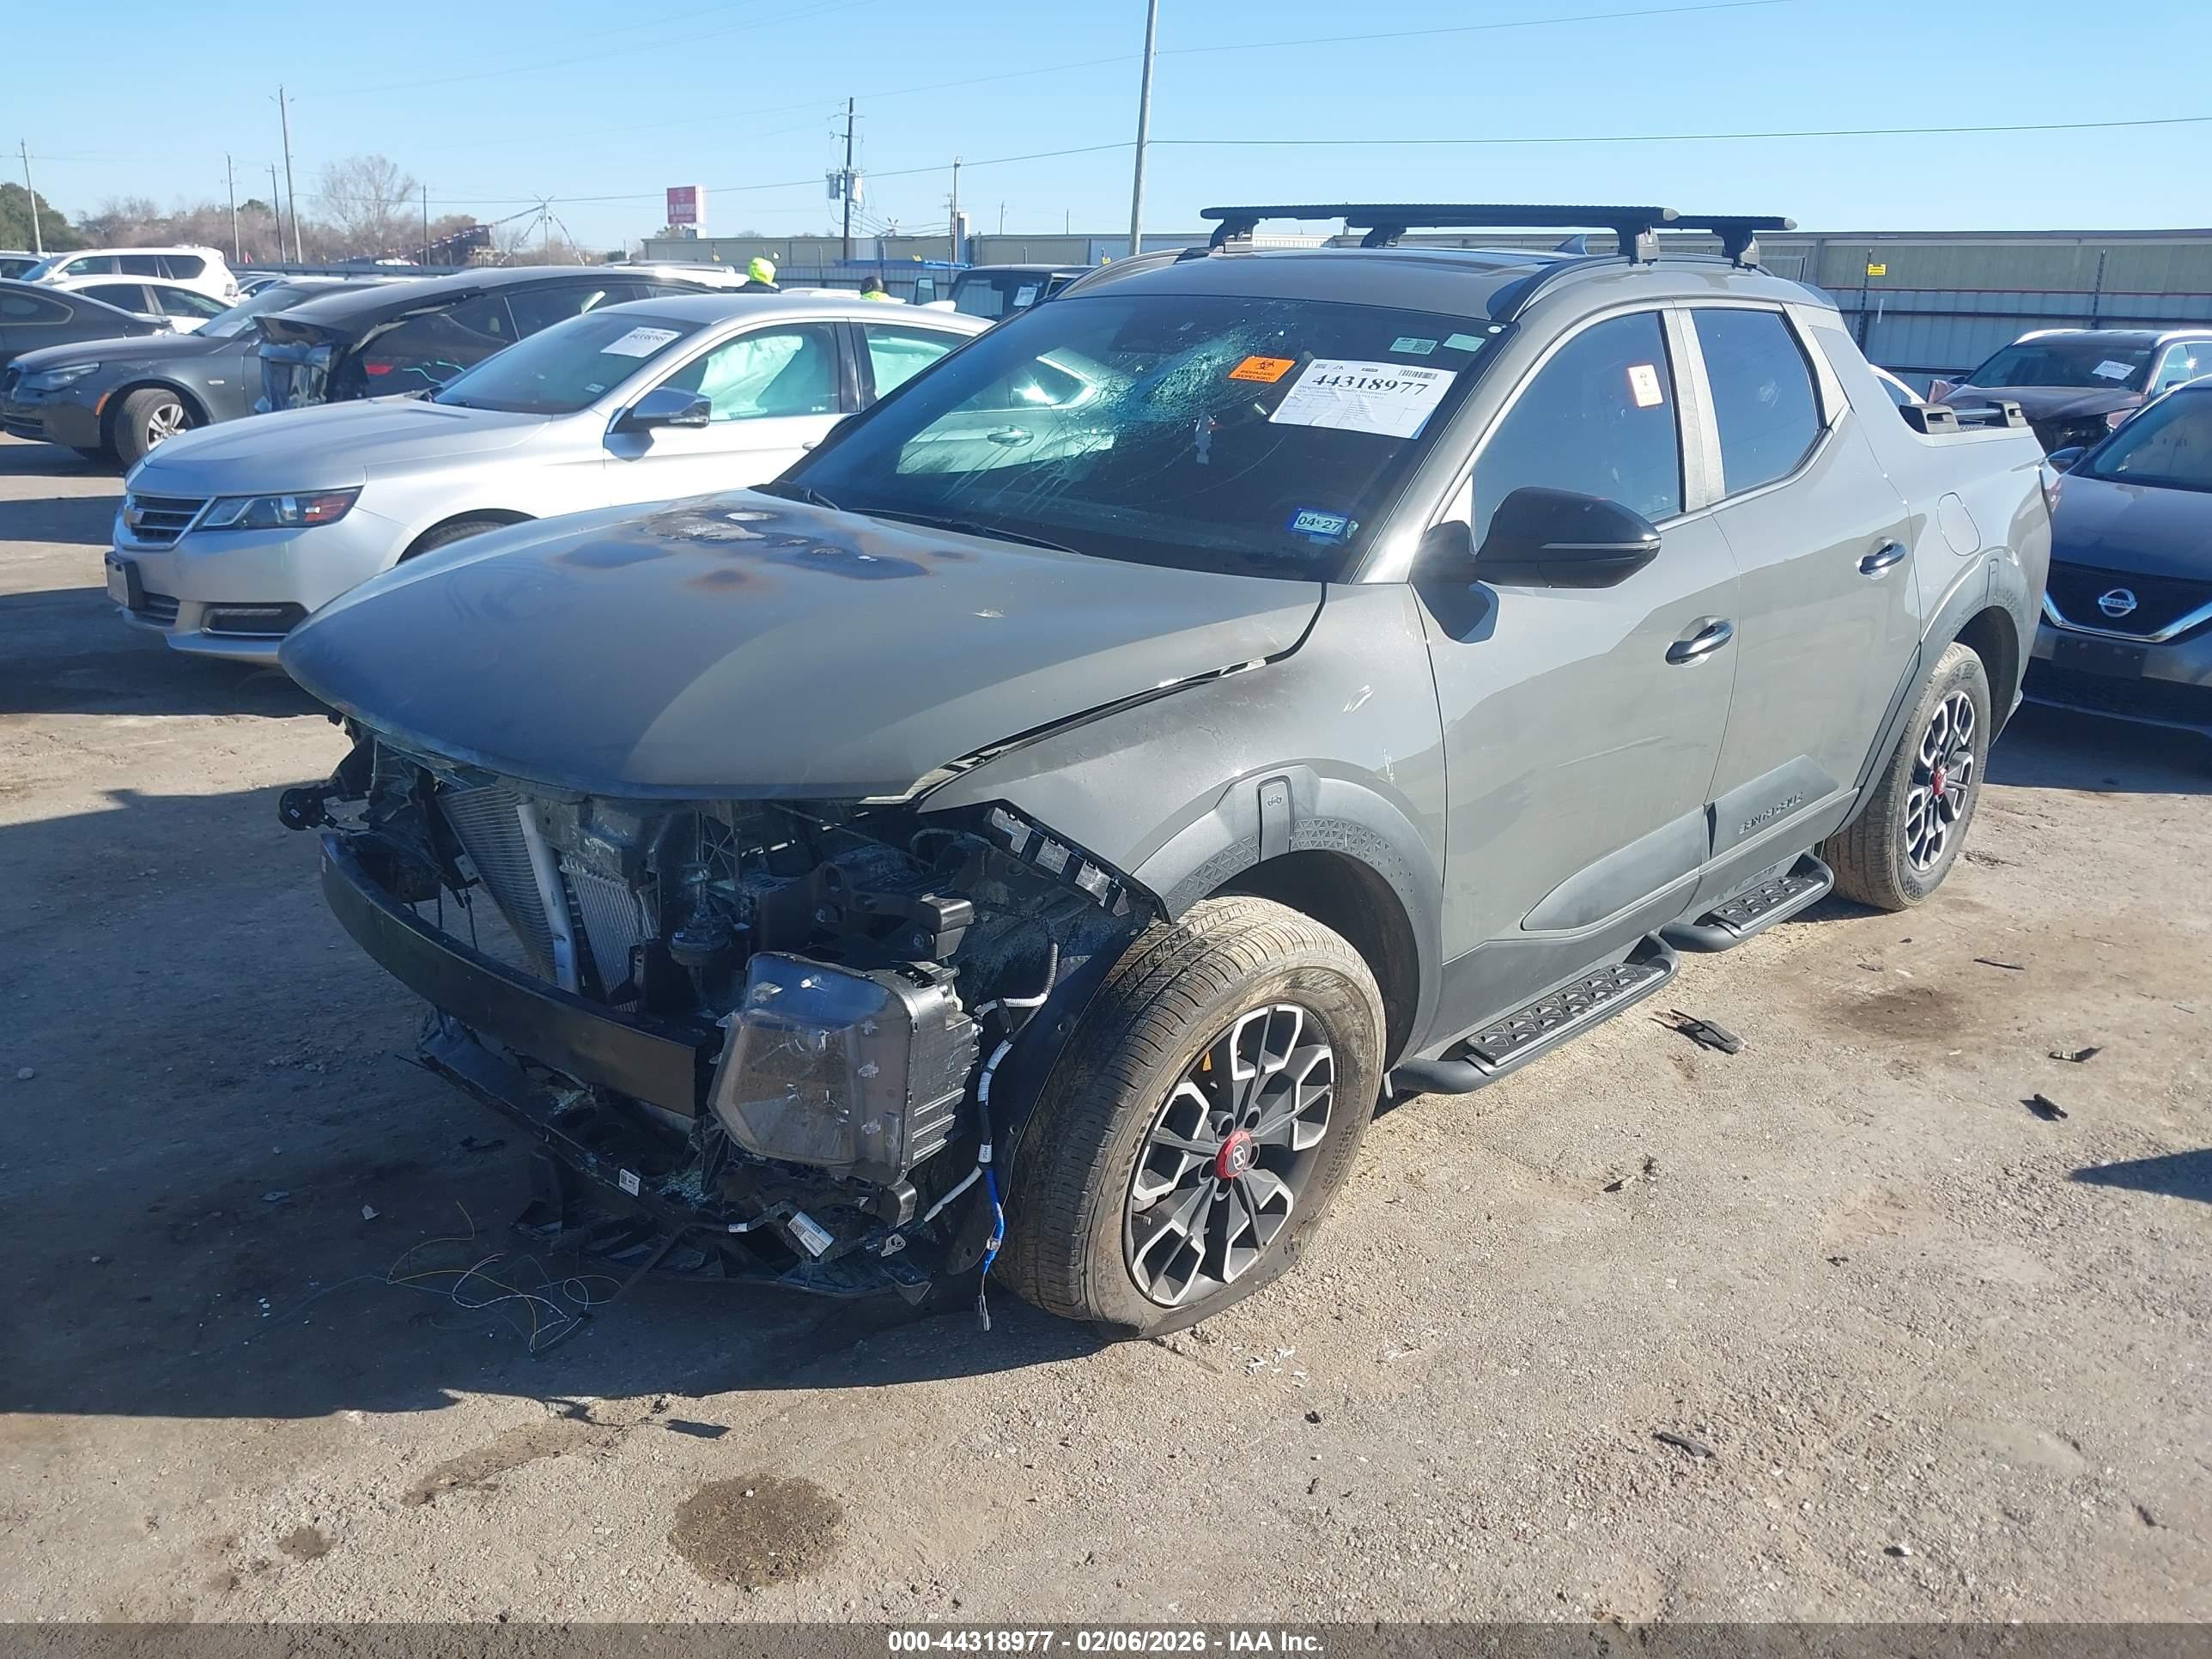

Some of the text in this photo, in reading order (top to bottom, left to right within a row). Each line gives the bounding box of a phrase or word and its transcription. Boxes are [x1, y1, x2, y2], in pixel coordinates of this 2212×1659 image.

[1312, 374, 1429, 395] 44318977
[1297, 517, 1342, 530] 04 27
